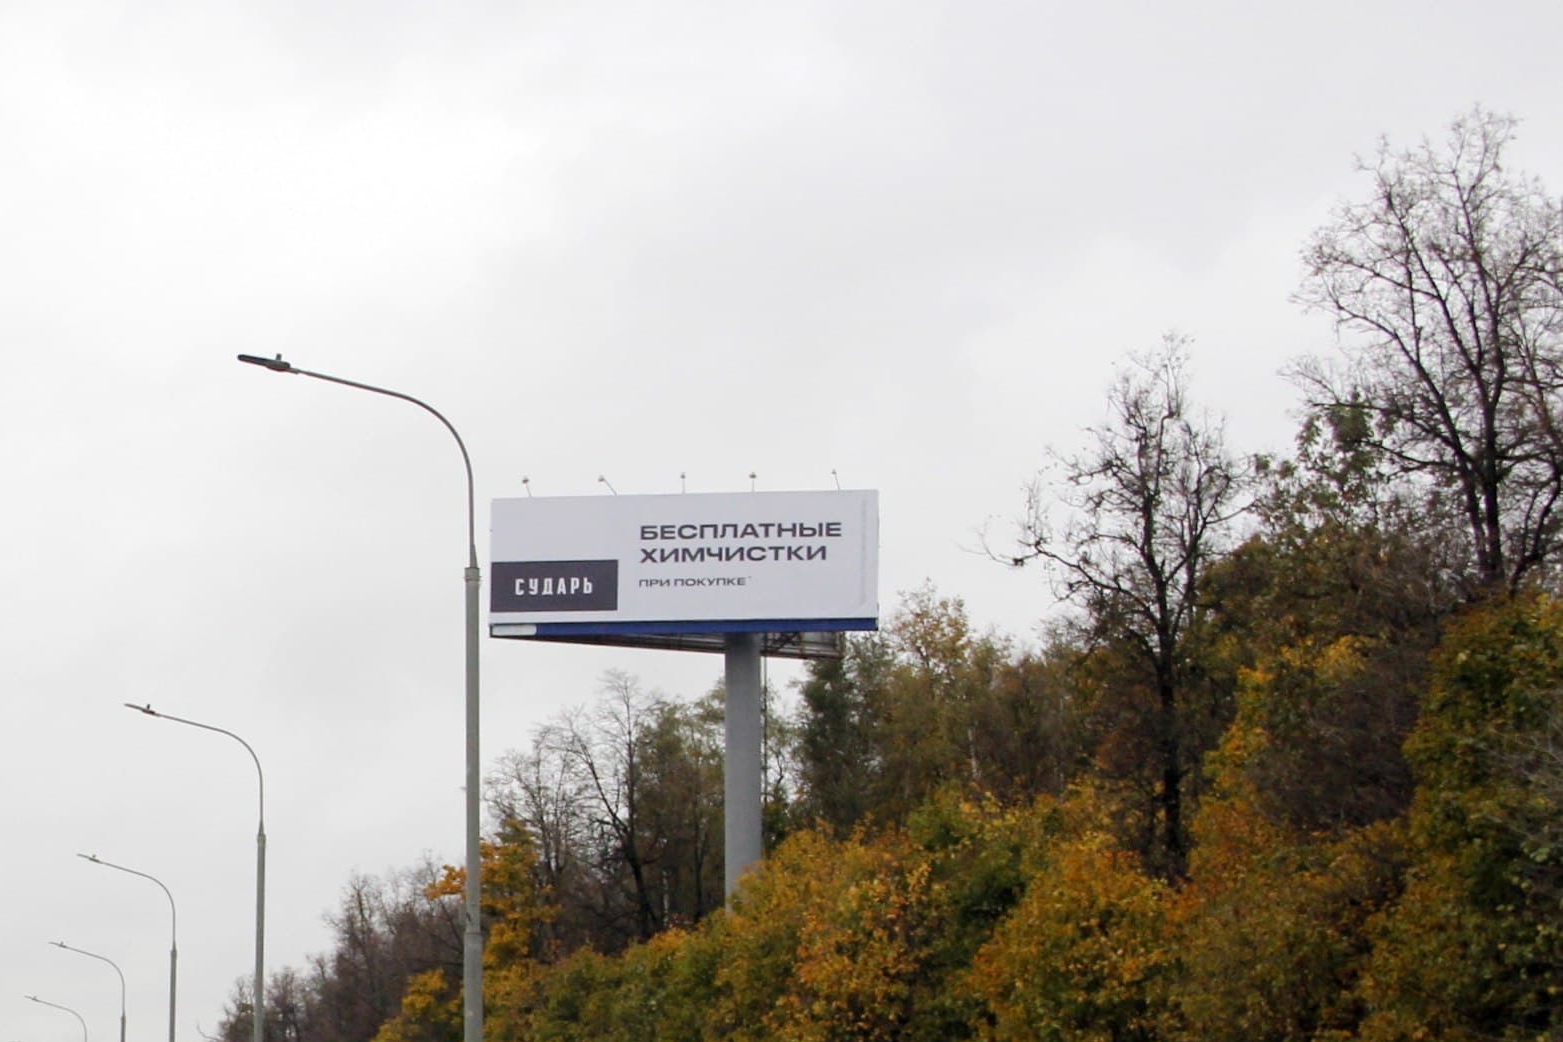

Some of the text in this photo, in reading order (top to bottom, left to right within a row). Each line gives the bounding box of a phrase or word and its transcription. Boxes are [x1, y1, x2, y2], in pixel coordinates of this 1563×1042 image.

[639, 522, 842, 540] БЕСПЛАТНЫЕ
[640, 545, 827, 563] ХИМЧИСТКИ
[515, 577, 593, 595] СУДАРЬ
[638, 578, 670, 587] ПРИ
